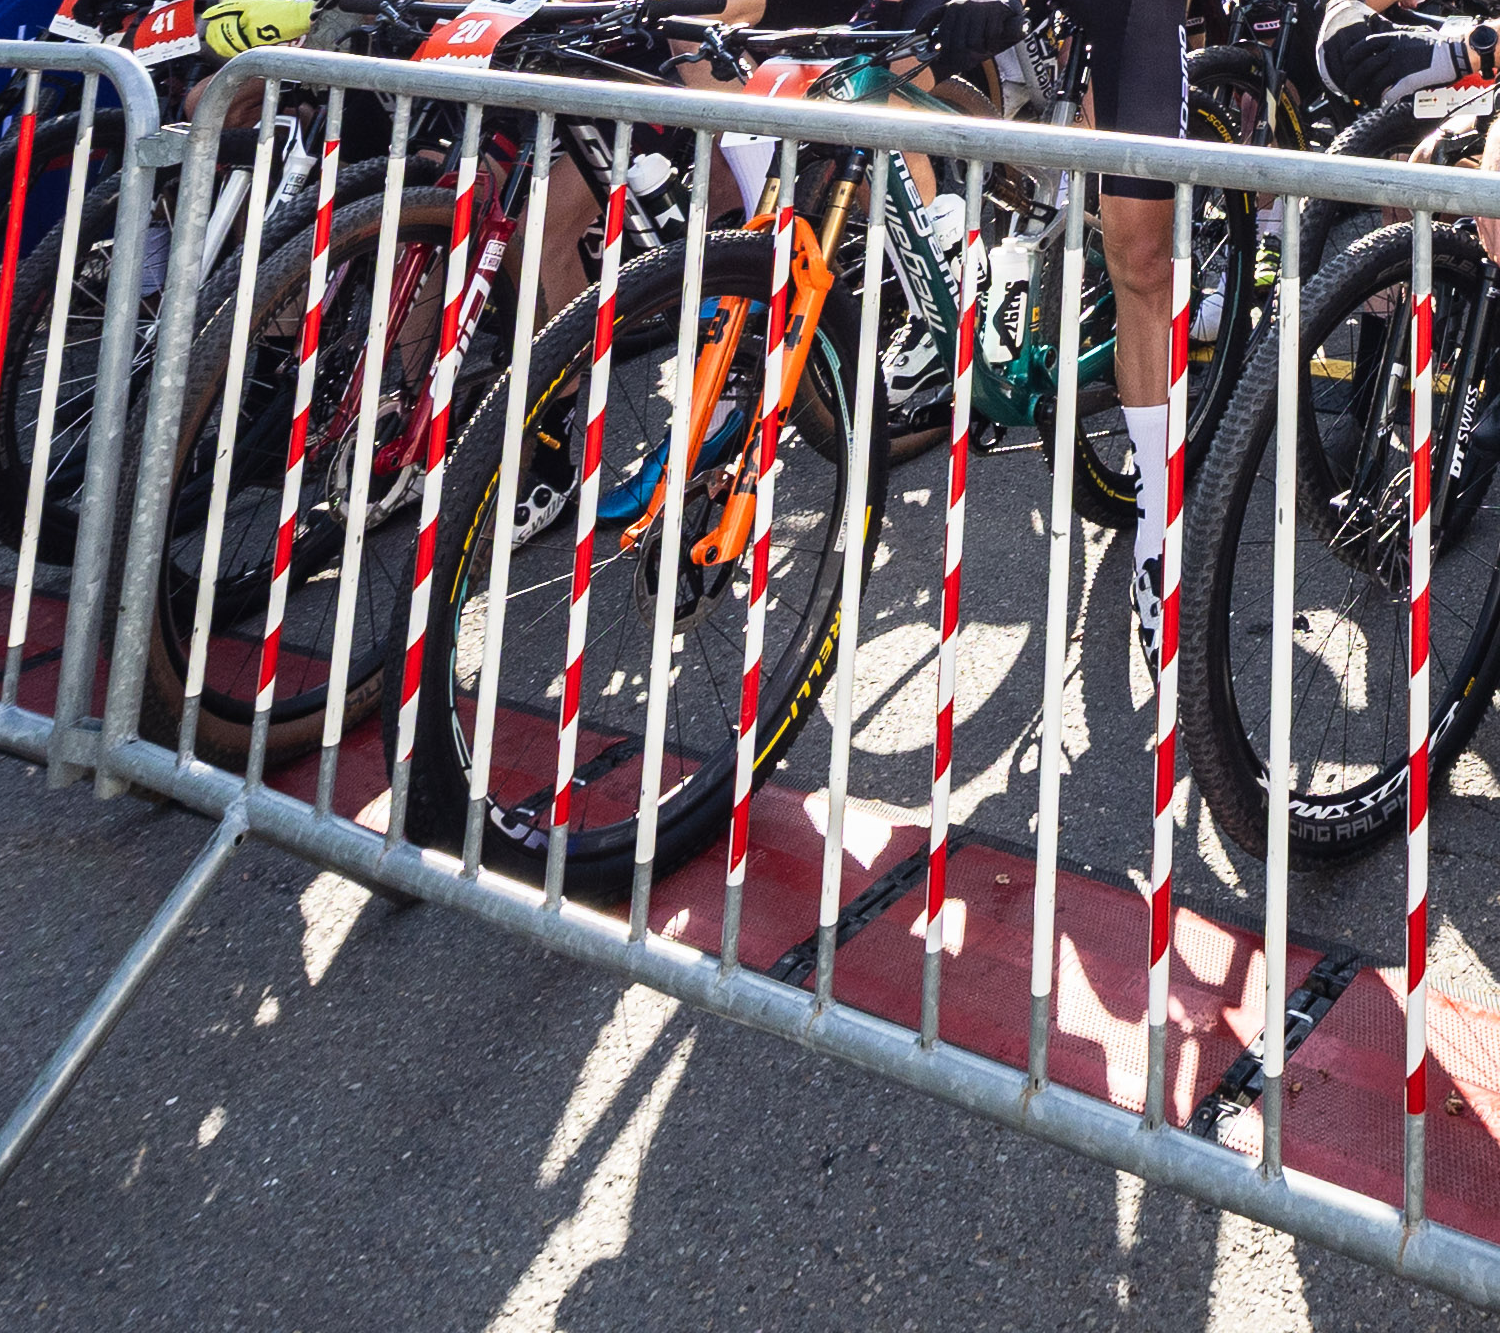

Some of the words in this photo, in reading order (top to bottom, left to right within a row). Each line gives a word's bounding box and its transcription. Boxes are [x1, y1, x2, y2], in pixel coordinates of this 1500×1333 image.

[151, 9, 176, 35] 41
[447, 19, 493, 44] 20
[1456, 383, 1480, 445] SWISS
[1449, 442, 1466, 480] DT
